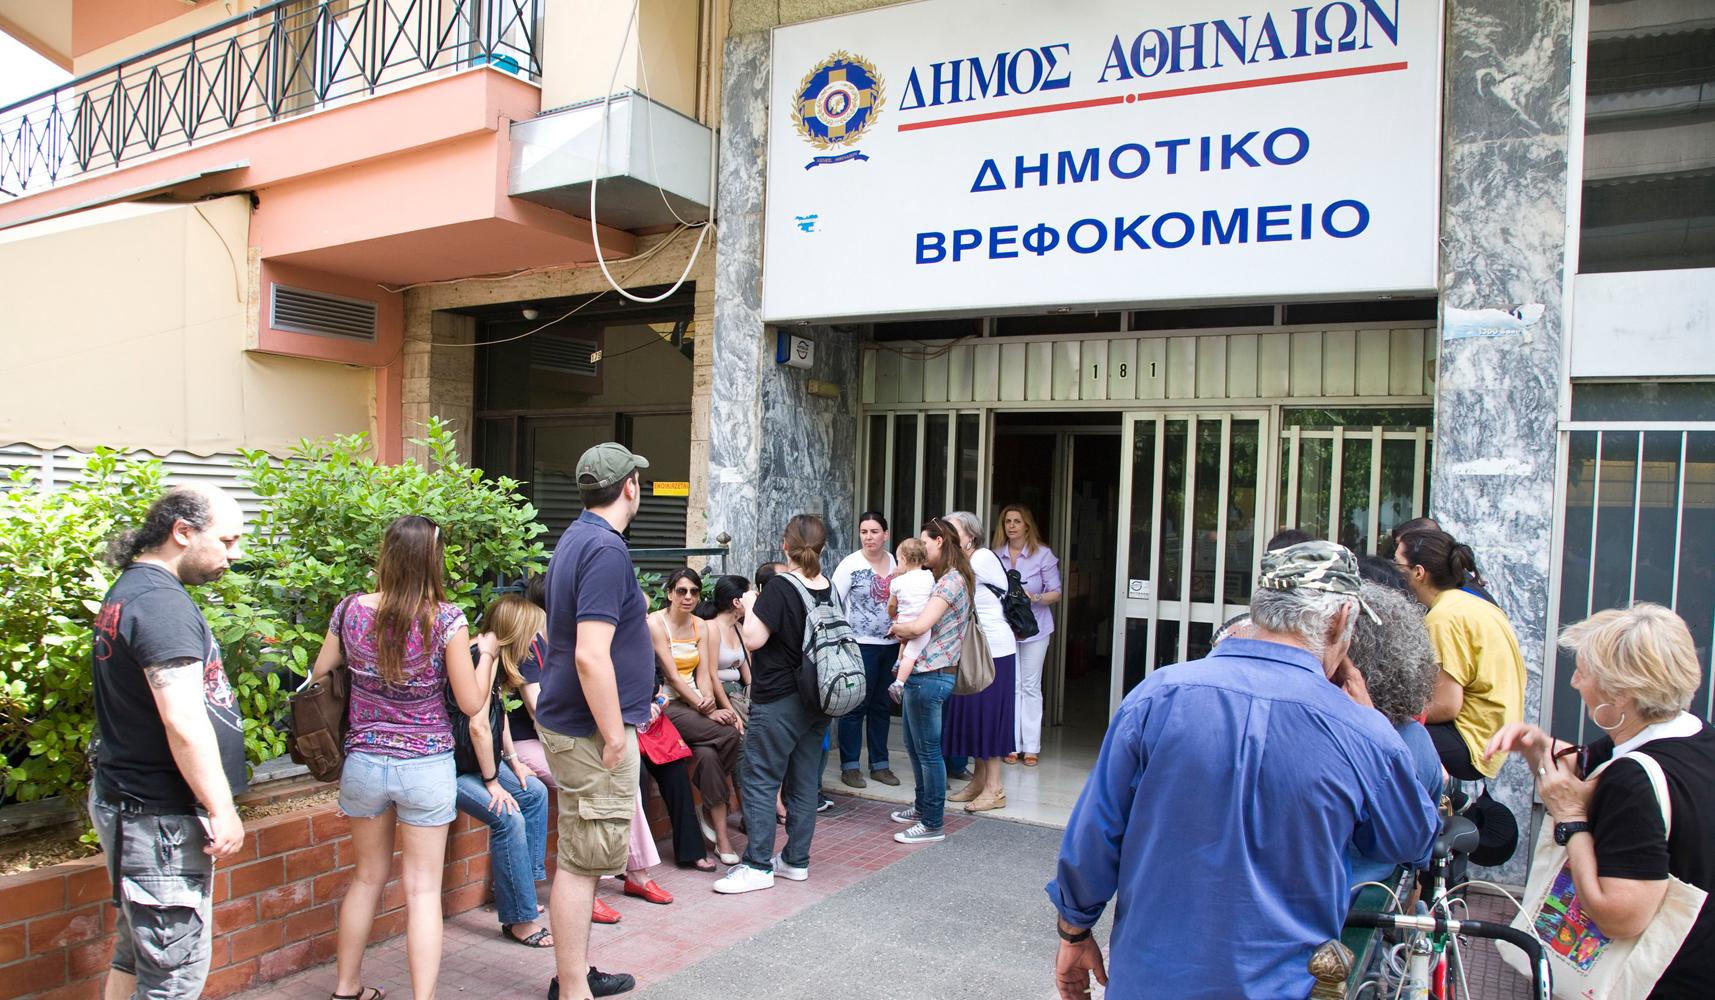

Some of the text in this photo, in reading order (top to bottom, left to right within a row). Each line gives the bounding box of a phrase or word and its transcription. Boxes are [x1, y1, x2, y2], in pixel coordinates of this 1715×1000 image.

[898, 0, 1400, 111] ΔΗΜΟΣ ΑΘΗΝΑΙΩΝ
[970, 126, 1310, 193] ΔΗΜΟΤΙΚΟ
[915, 199, 1371, 265] ΒΡΕΦΟΚΟΜΕΙΟ
